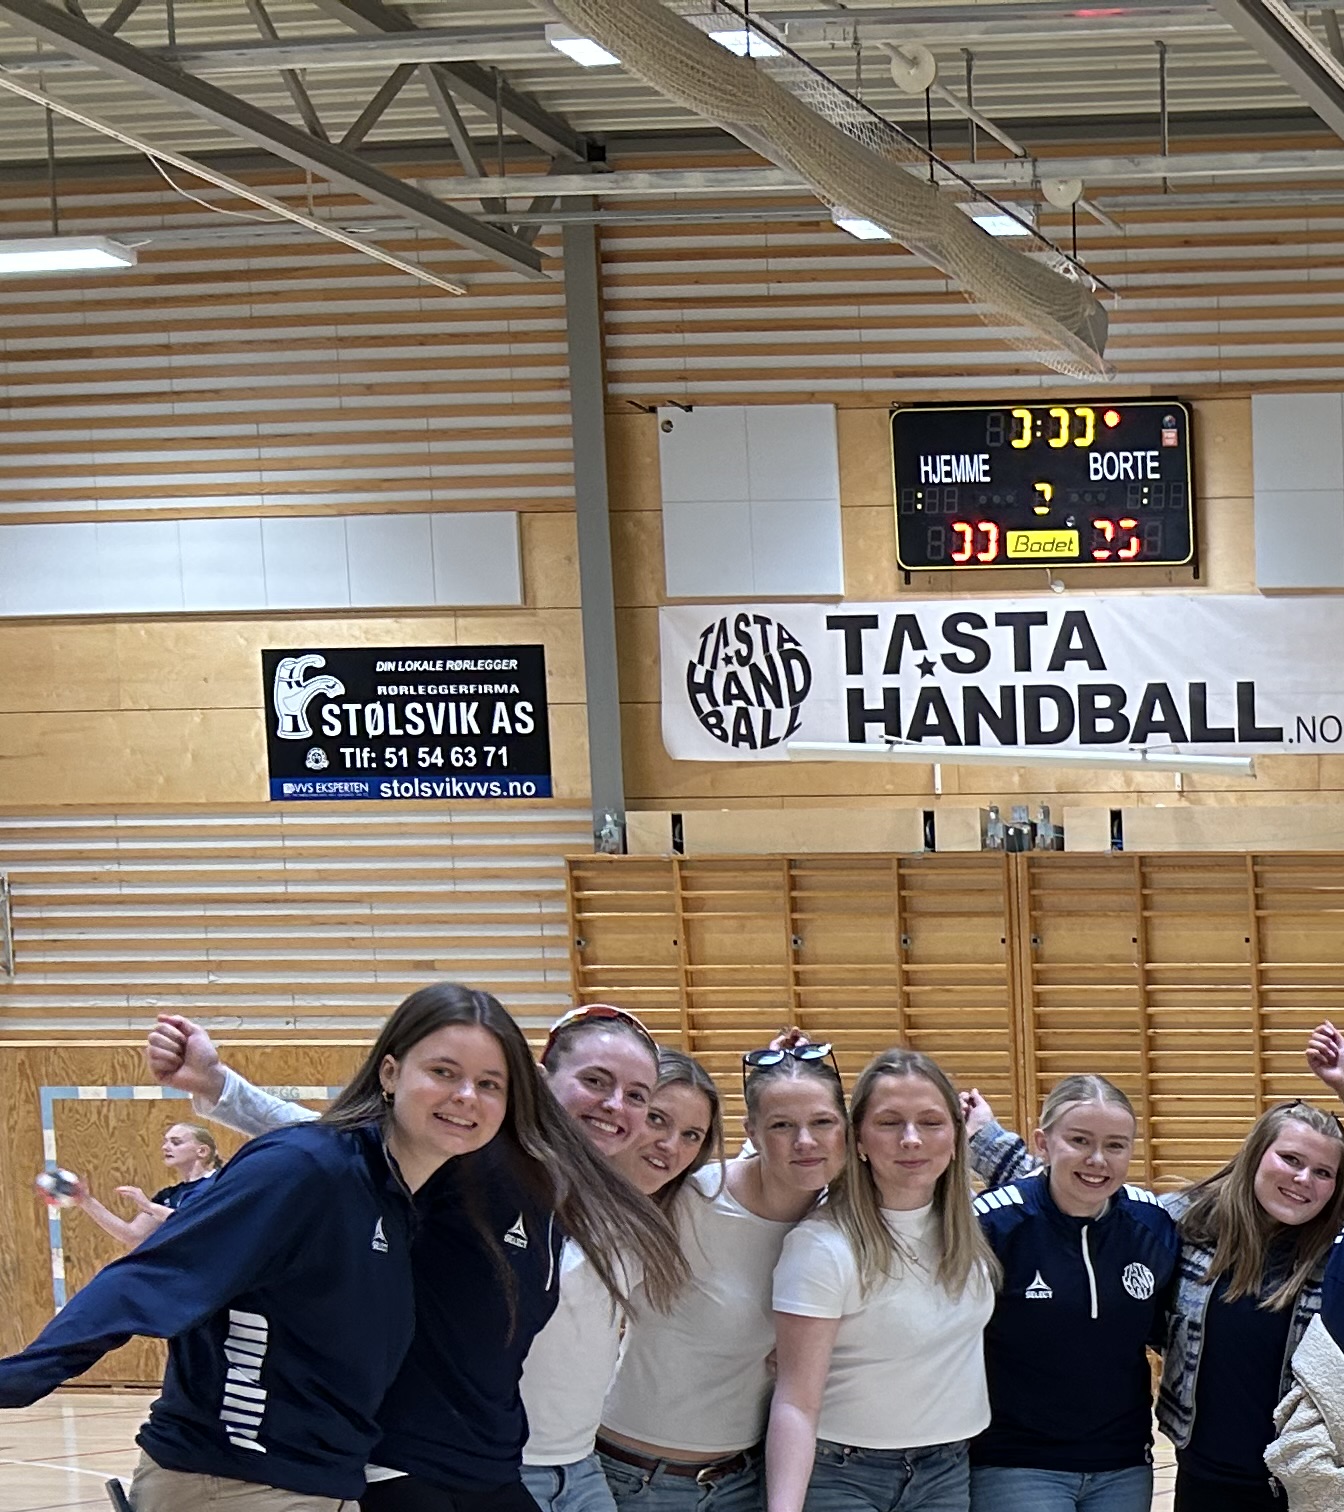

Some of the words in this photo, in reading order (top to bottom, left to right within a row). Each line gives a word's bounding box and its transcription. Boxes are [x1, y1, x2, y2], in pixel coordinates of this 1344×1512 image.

[920, 454, 991, 484] HJEMME
[1089, 450, 1161, 481] BORTE
[698, 613, 803, 671] TASTA
[826, 610, 1107, 676] TASTA
[376, 661, 396, 672] DIN
[398, 660, 444, 671] LOKALE
[687, 648, 812, 716] HAND
[321, 702, 481, 738] STØLSVIK
[491, 701, 535, 735] AS
[700, 704, 803, 750] BALL
[340, 747, 376, 768] Tlf:
[385, 747, 409, 768] 51
[417, 747, 443, 767] 54
[451, 747, 477, 767] 63
[484, 746, 508, 767] 71
[316, 782, 369, 793] EKSPERTEN
[380, 778, 536, 798] stolsvikvvs.no
